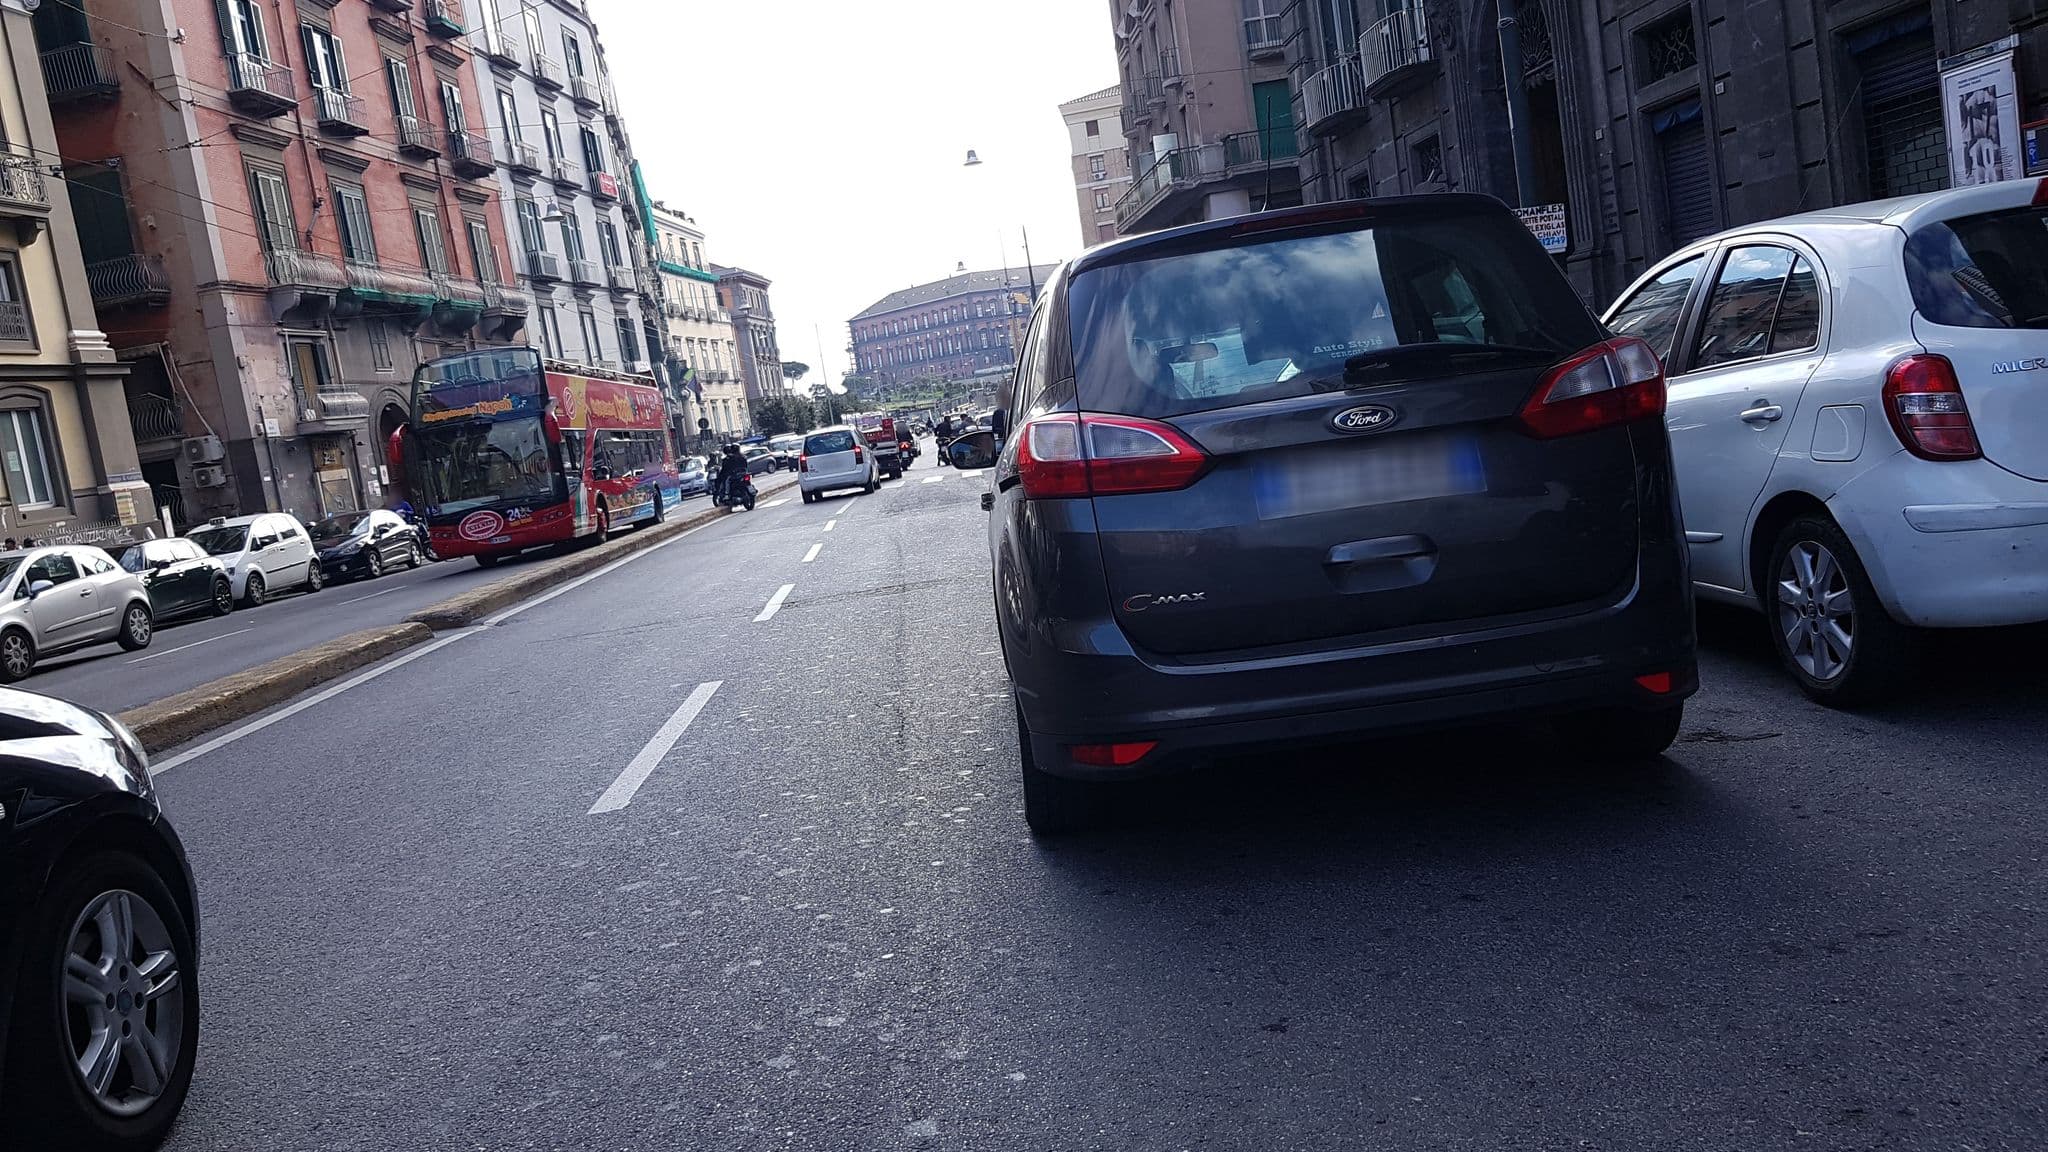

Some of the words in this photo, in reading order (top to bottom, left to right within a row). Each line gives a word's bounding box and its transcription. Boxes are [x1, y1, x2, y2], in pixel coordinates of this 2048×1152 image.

[1537, 230, 1564, 239] CHIAVI
[1313, 343, 1345, 354] Auto
[1347, 410, 1381, 426] Ford
